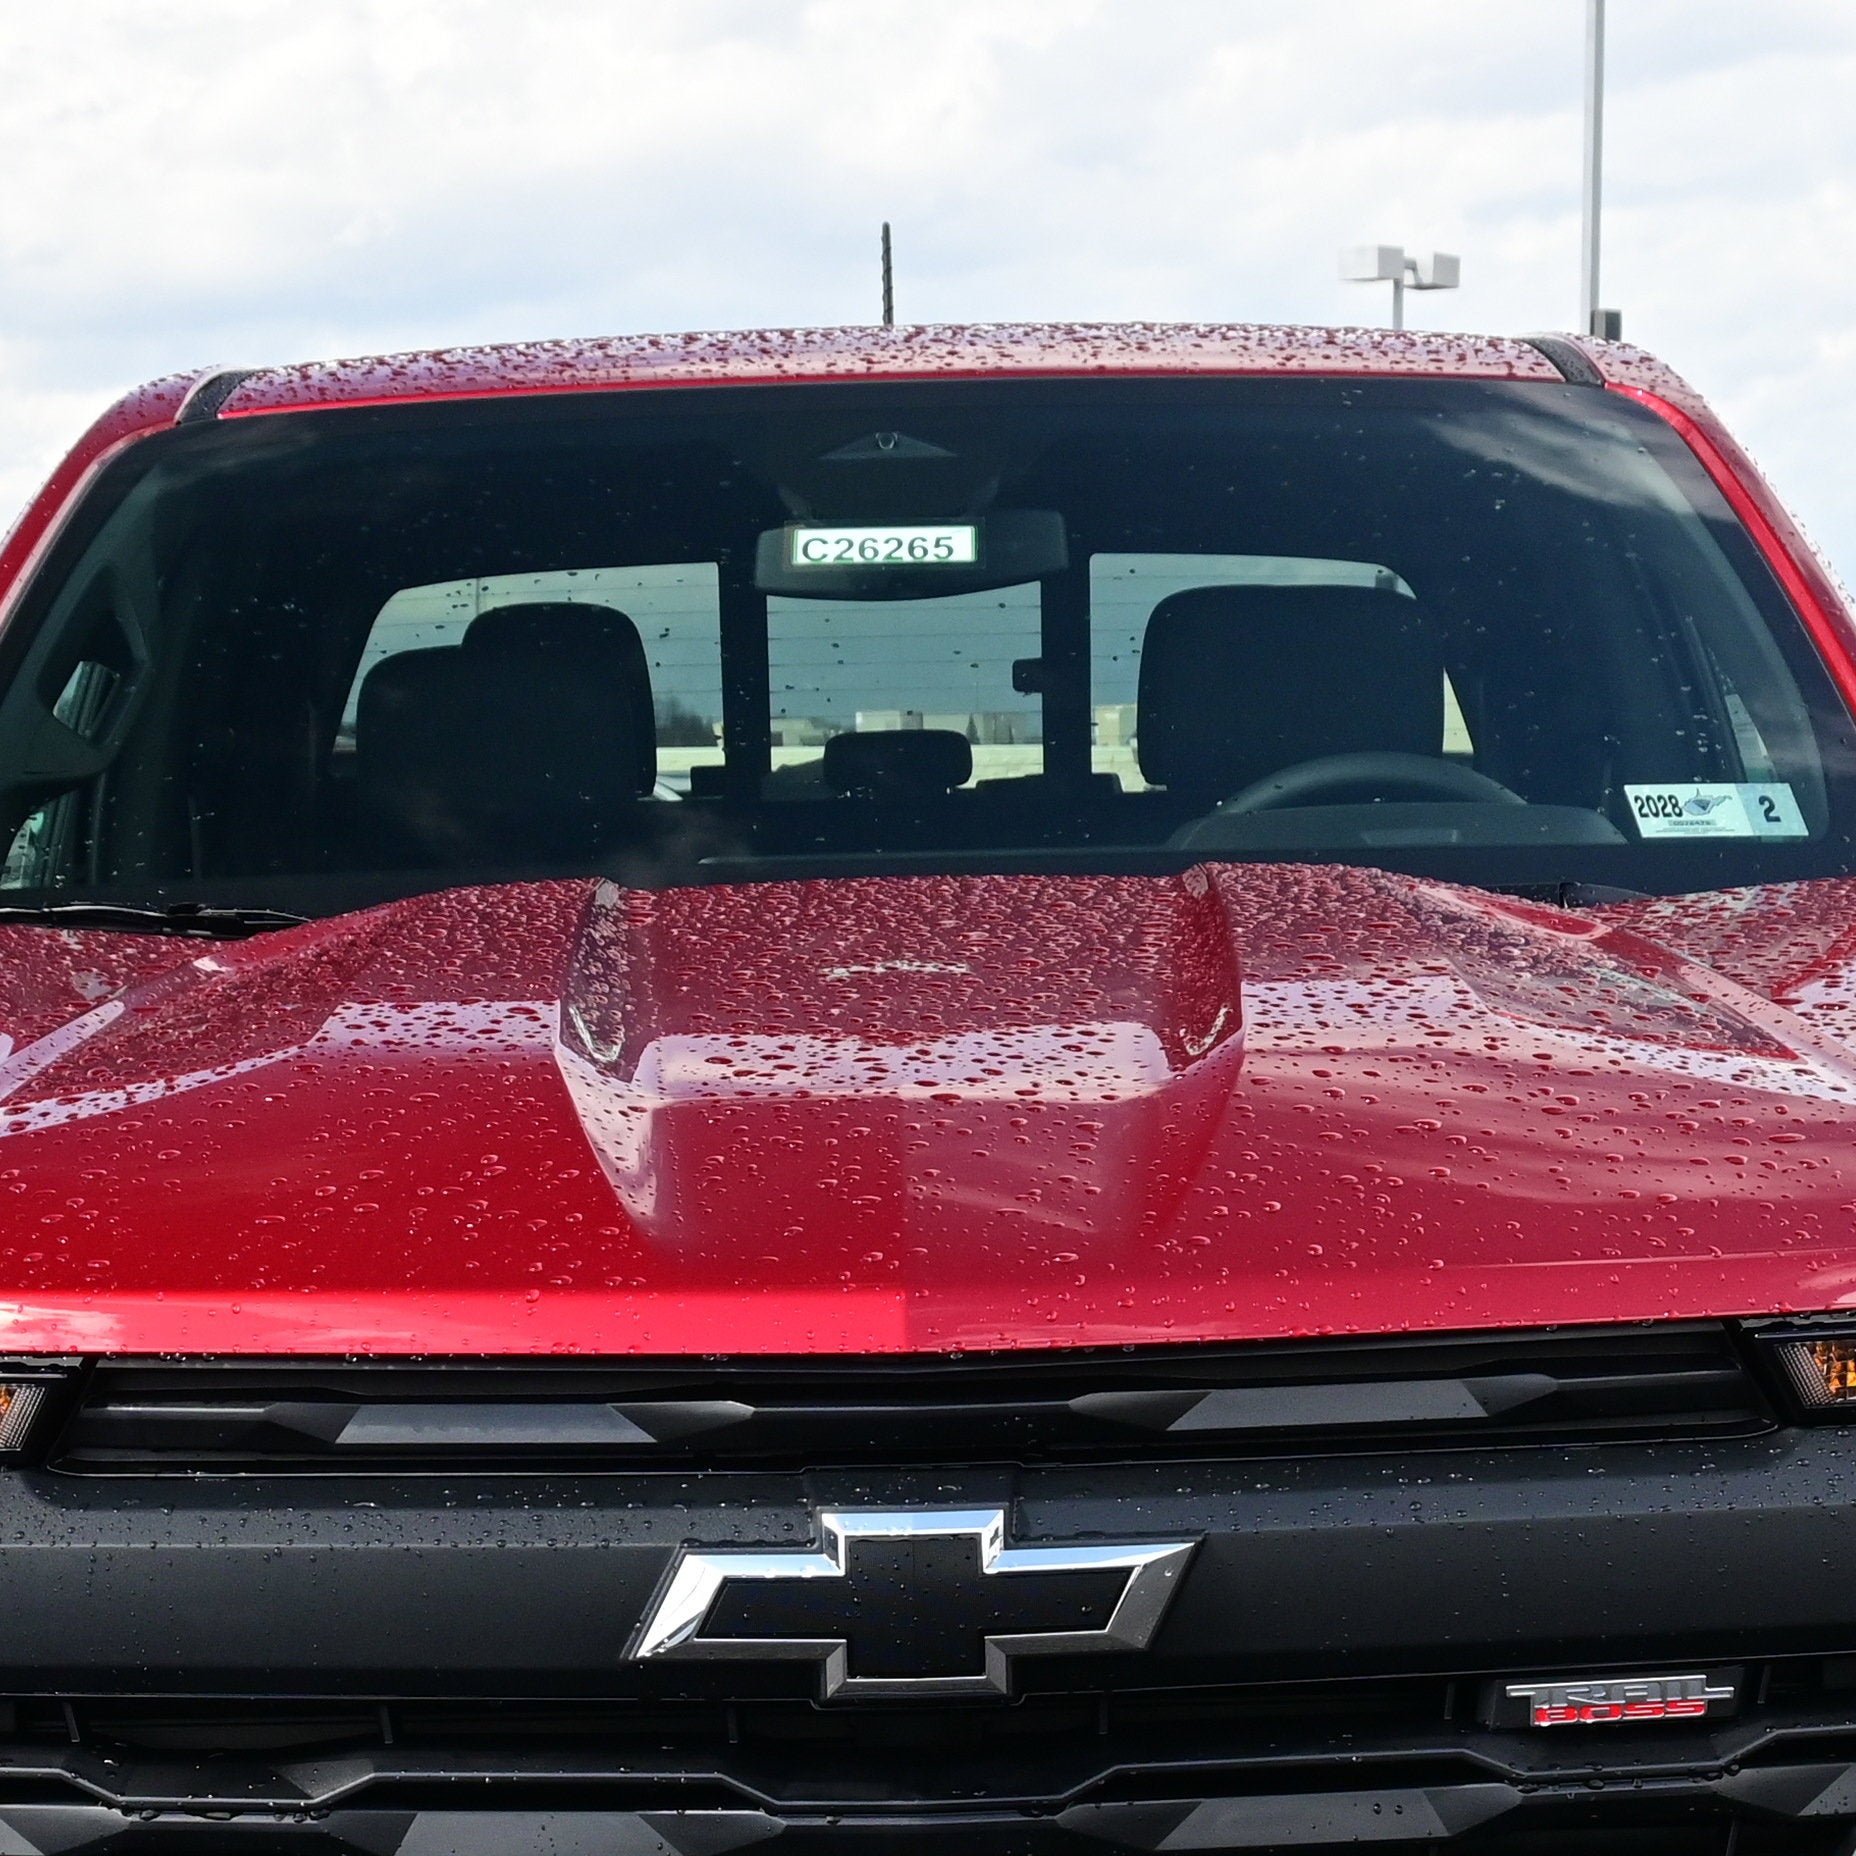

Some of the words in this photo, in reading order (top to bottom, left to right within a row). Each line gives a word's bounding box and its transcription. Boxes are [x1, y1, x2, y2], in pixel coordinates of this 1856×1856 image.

[801, 536, 954, 563] C26265
[1634, 794, 1684, 818] 2028
[1758, 795, 1782, 822] 2
[1505, 1675, 1735, 1709] TRAIL
[1532, 1699, 1707, 1727] BOSS
